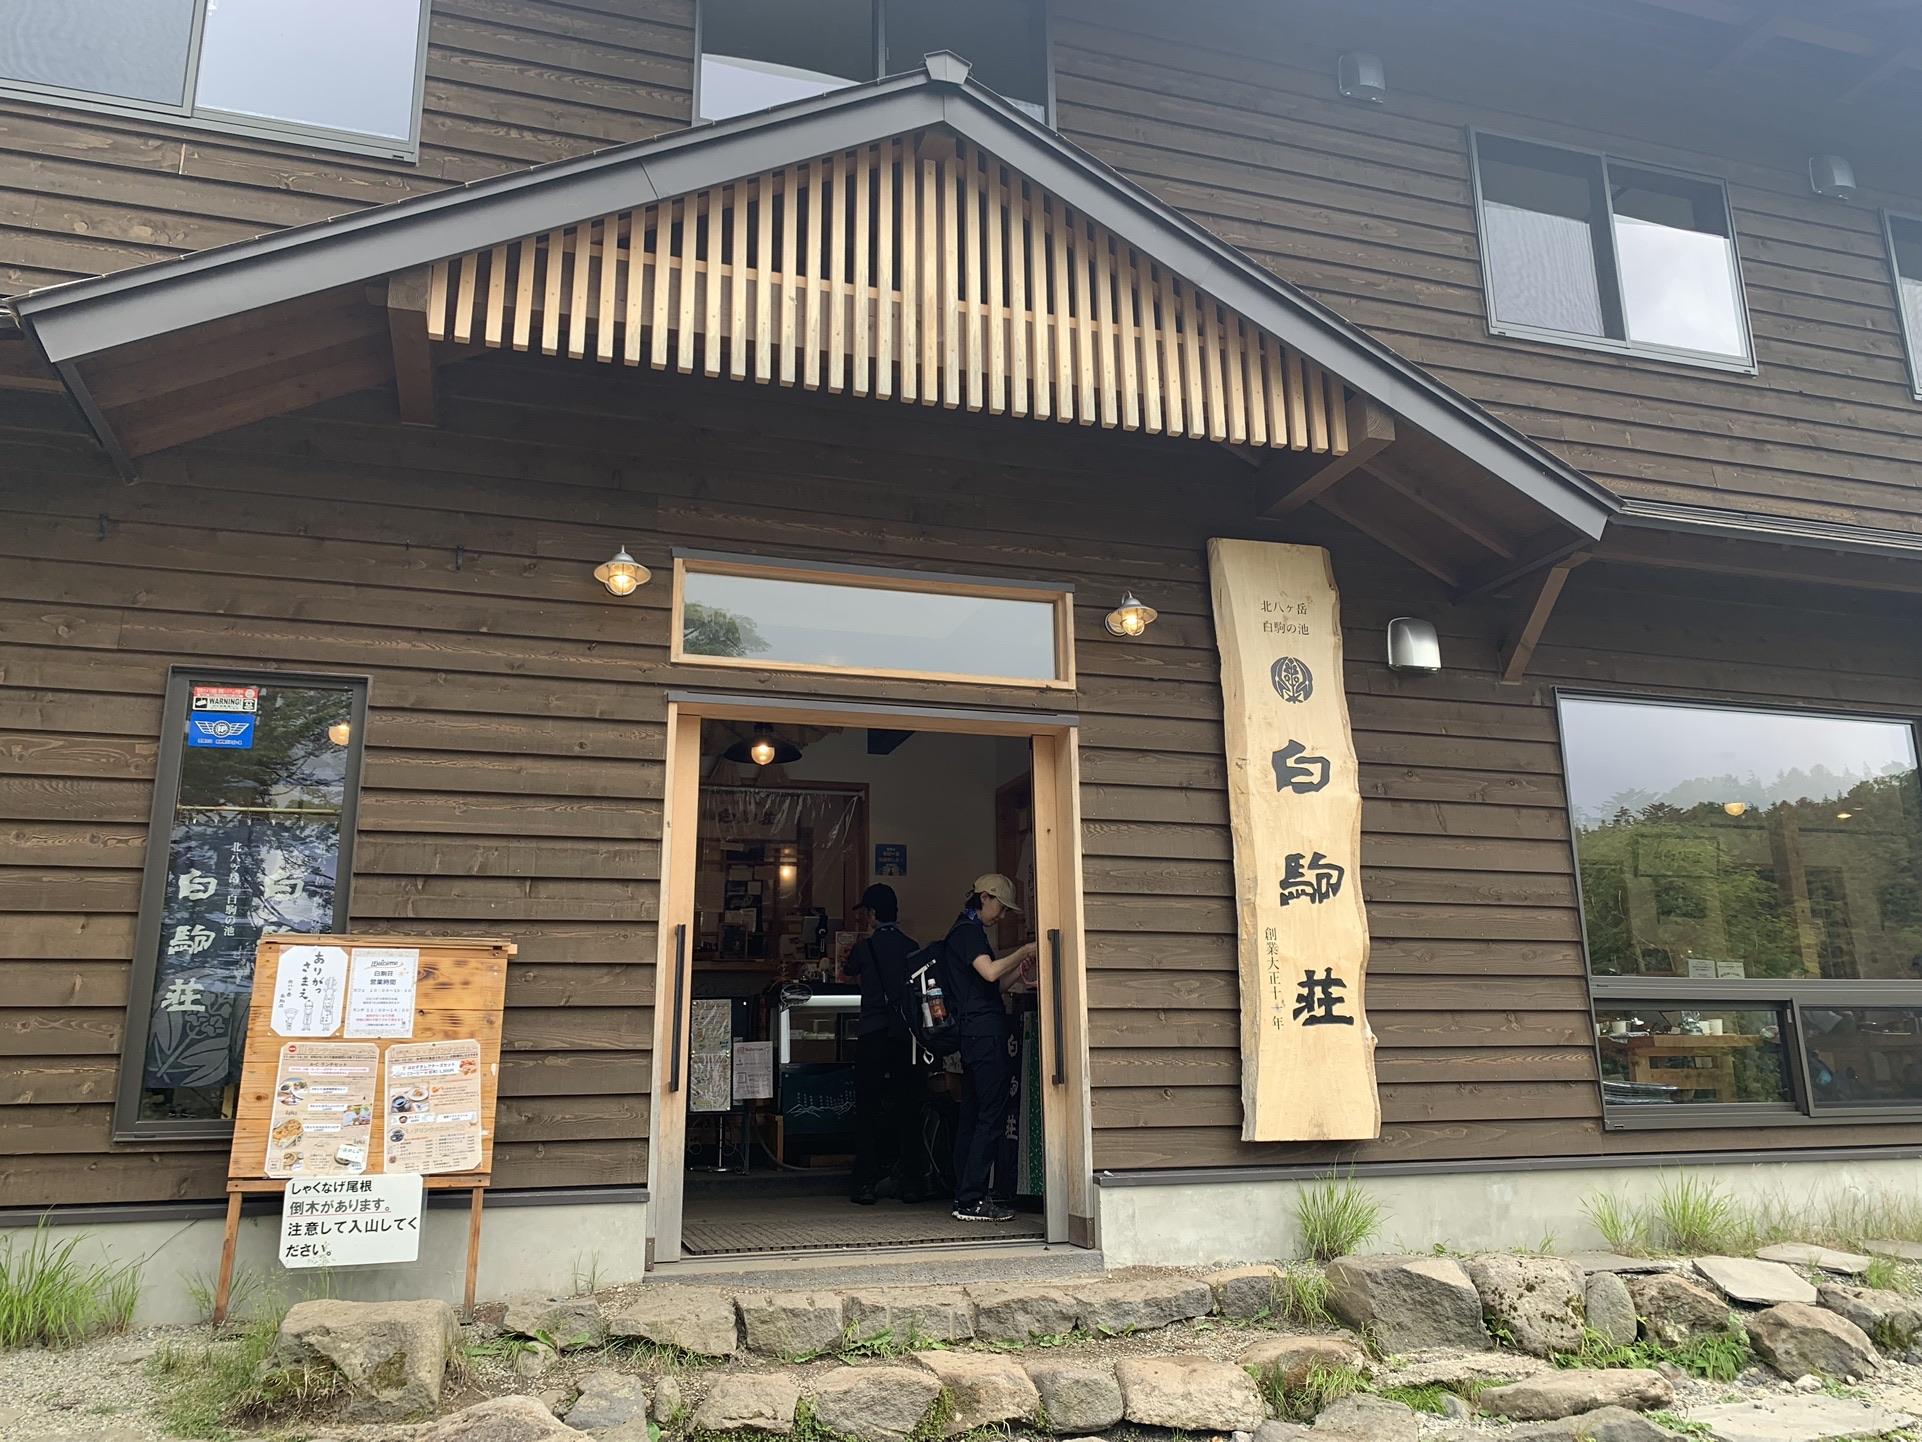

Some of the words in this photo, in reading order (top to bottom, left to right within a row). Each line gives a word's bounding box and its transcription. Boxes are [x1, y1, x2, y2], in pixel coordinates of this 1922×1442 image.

[1261, 600, 1308, 616] 北八ヶ岳
[1263, 620, 1310, 636] 白駒の池
[208, 697, 242, 706] WARNING!
[1271, 738, 1354, 1027] 白駒荘
[223, 894, 238, 937] 白駒の池
[161, 867, 219, 1013] 白駒荘
[369, 978, 397, 986] 営業時間
[291, 1180, 373, 1195] しゃくなげ尾根
[289, 1197, 391, 1216] 倒木があります。
[287, 1216, 418, 1237] 注意して入山してく
[285, 1244, 332, 1258] ださい。
